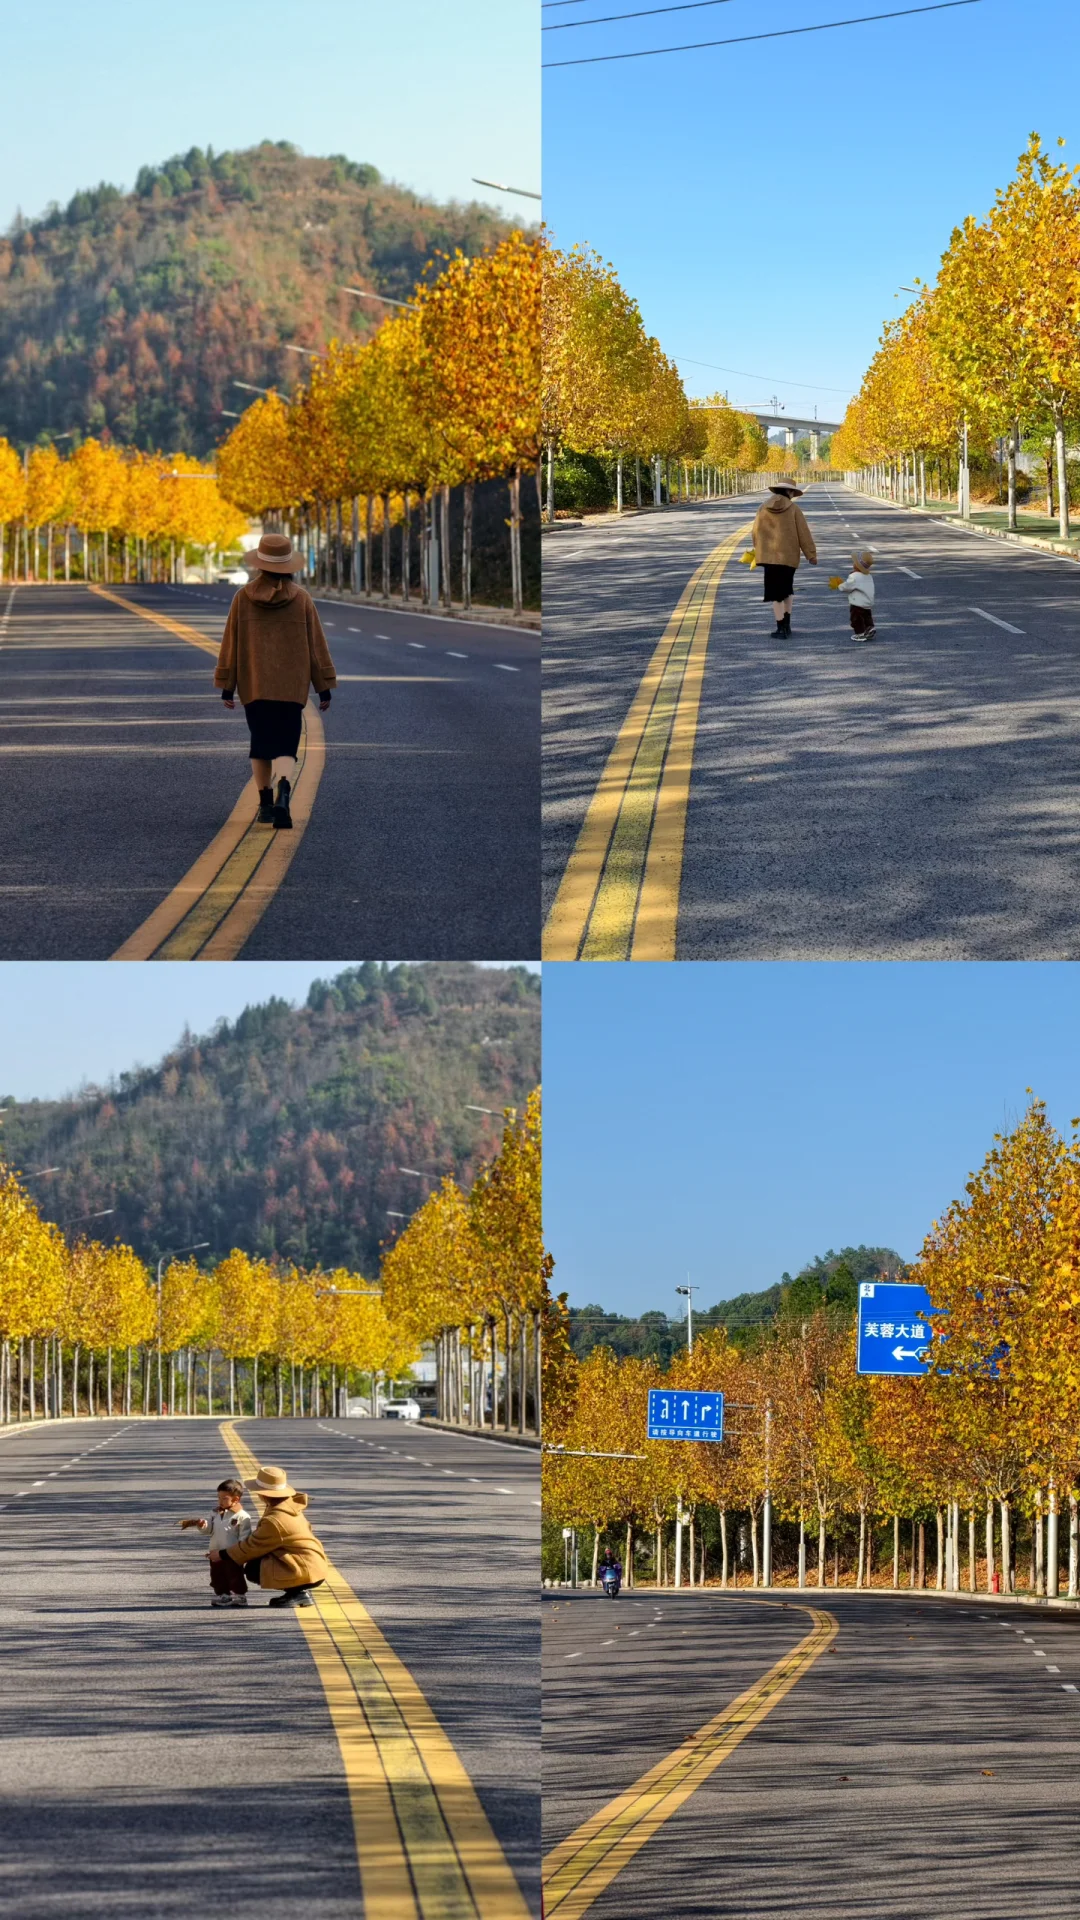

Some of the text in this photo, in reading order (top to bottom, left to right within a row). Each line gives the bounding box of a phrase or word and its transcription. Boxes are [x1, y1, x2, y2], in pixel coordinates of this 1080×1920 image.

[864, 1284, 871, 1292] 北
[864, 1322, 925, 1339] 芙蓉大道
[652, 1428, 718, 1438] 请按导向车道行驶
